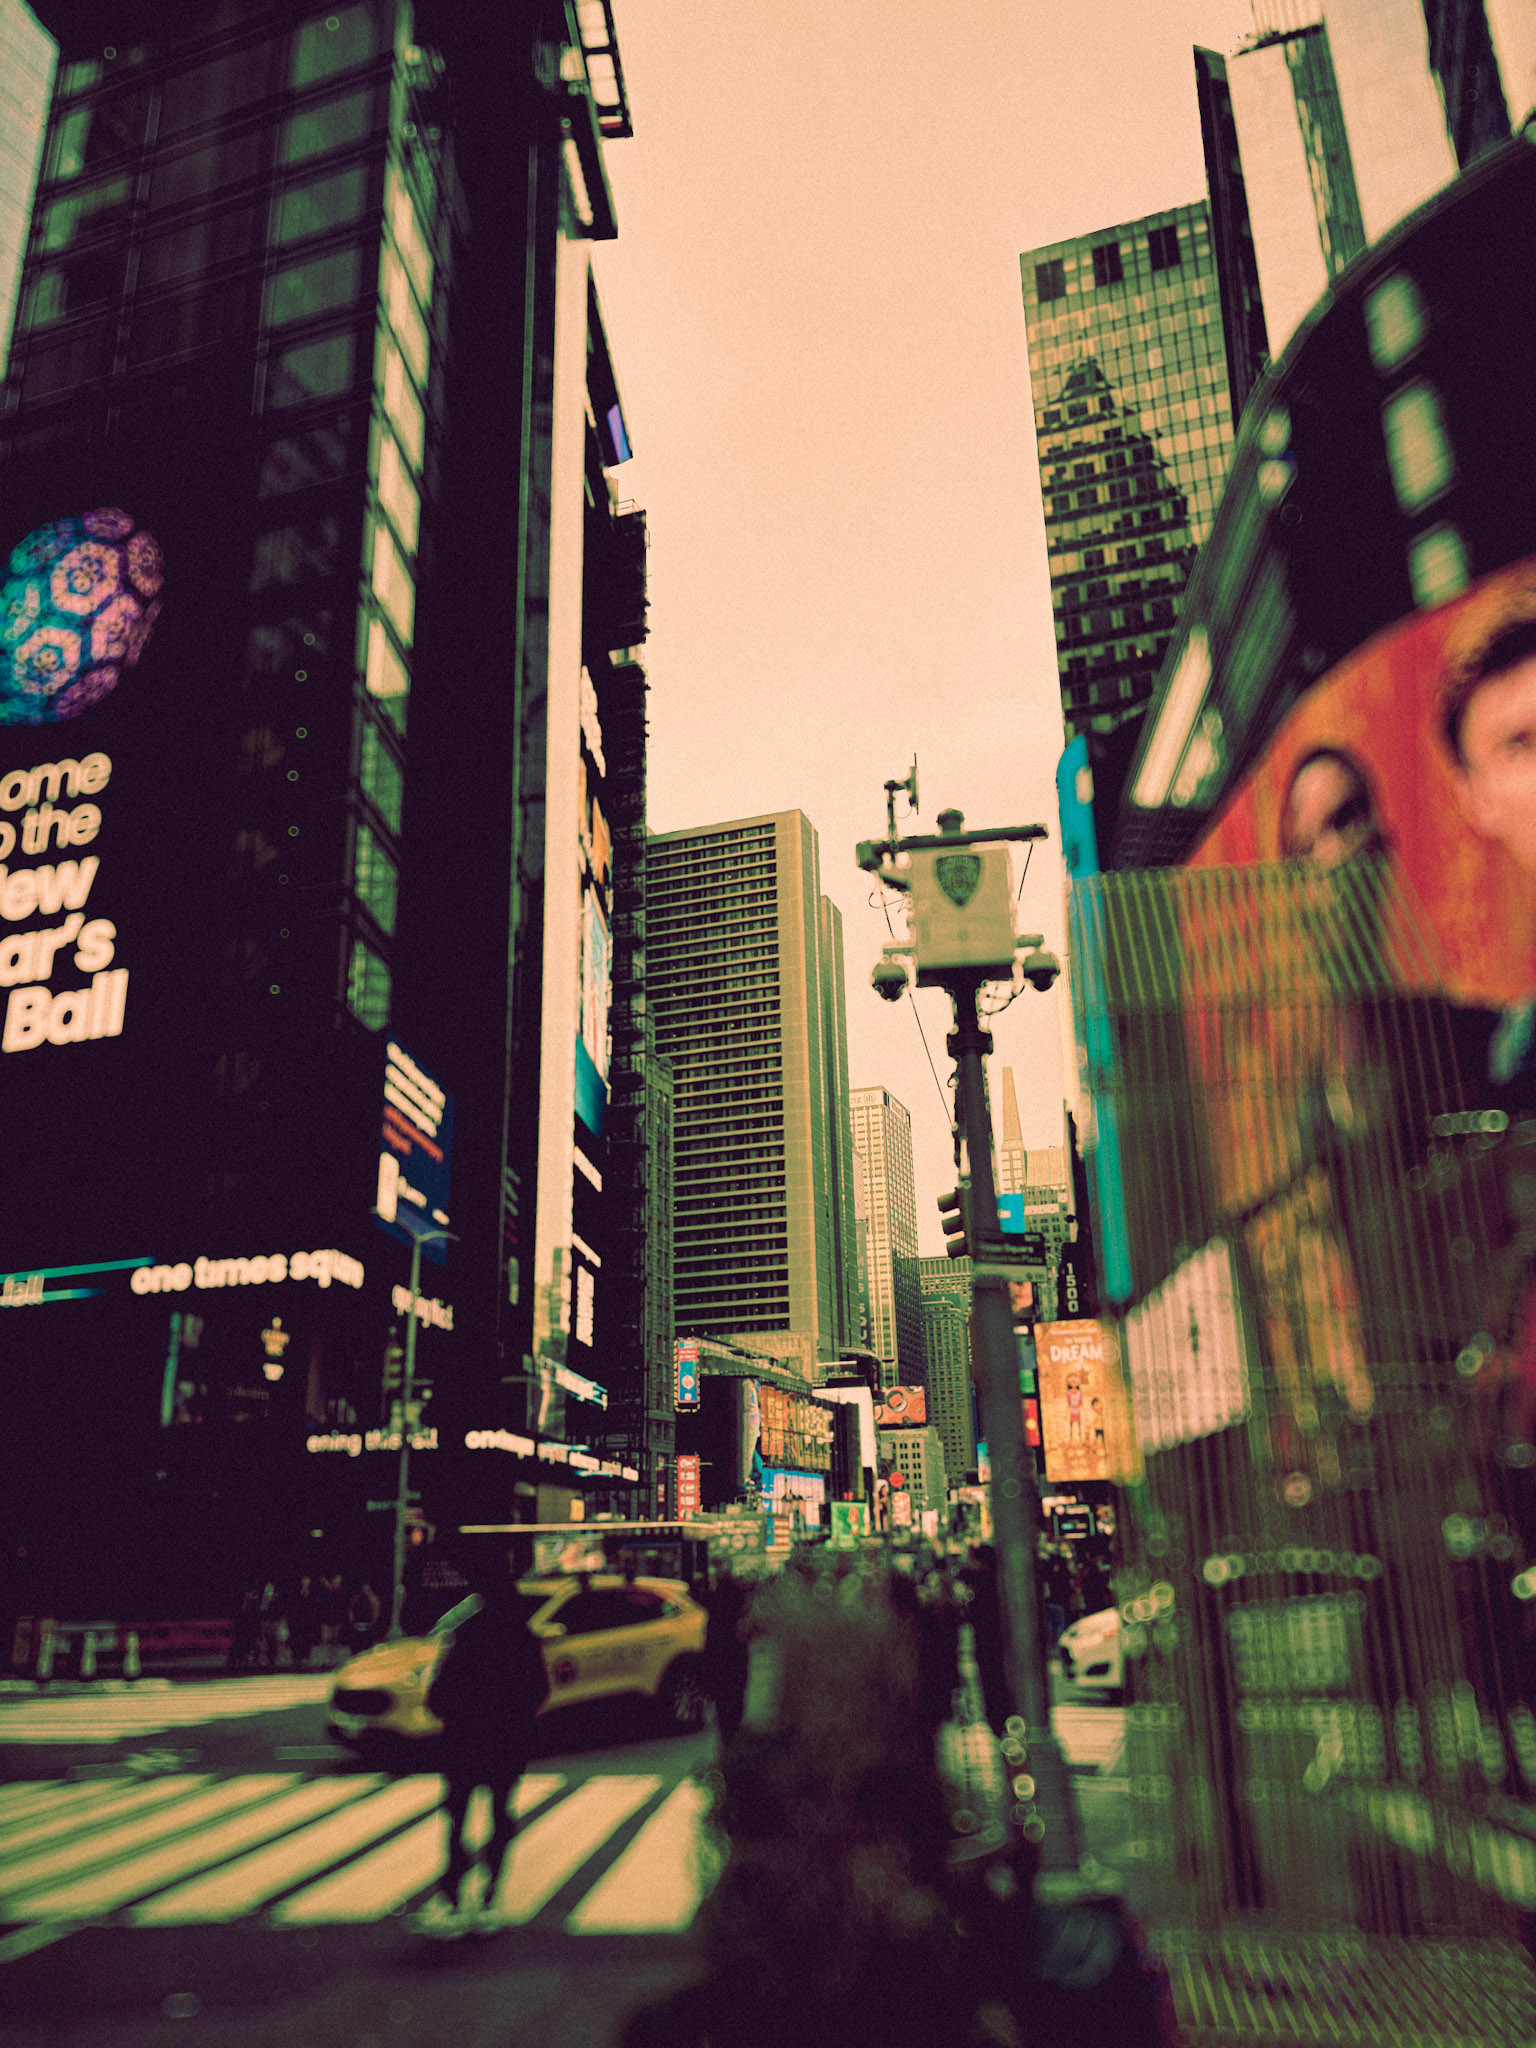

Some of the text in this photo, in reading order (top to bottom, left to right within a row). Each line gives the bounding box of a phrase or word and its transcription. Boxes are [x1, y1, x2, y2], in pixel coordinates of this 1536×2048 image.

[0, 752, 112, 811] ome
[22, 802, 102, 854] the
[2, 968, 129, 1052] Ball
[131, 1263, 193, 1295] one
[1065, 1262, 1079, 1313] 1500
